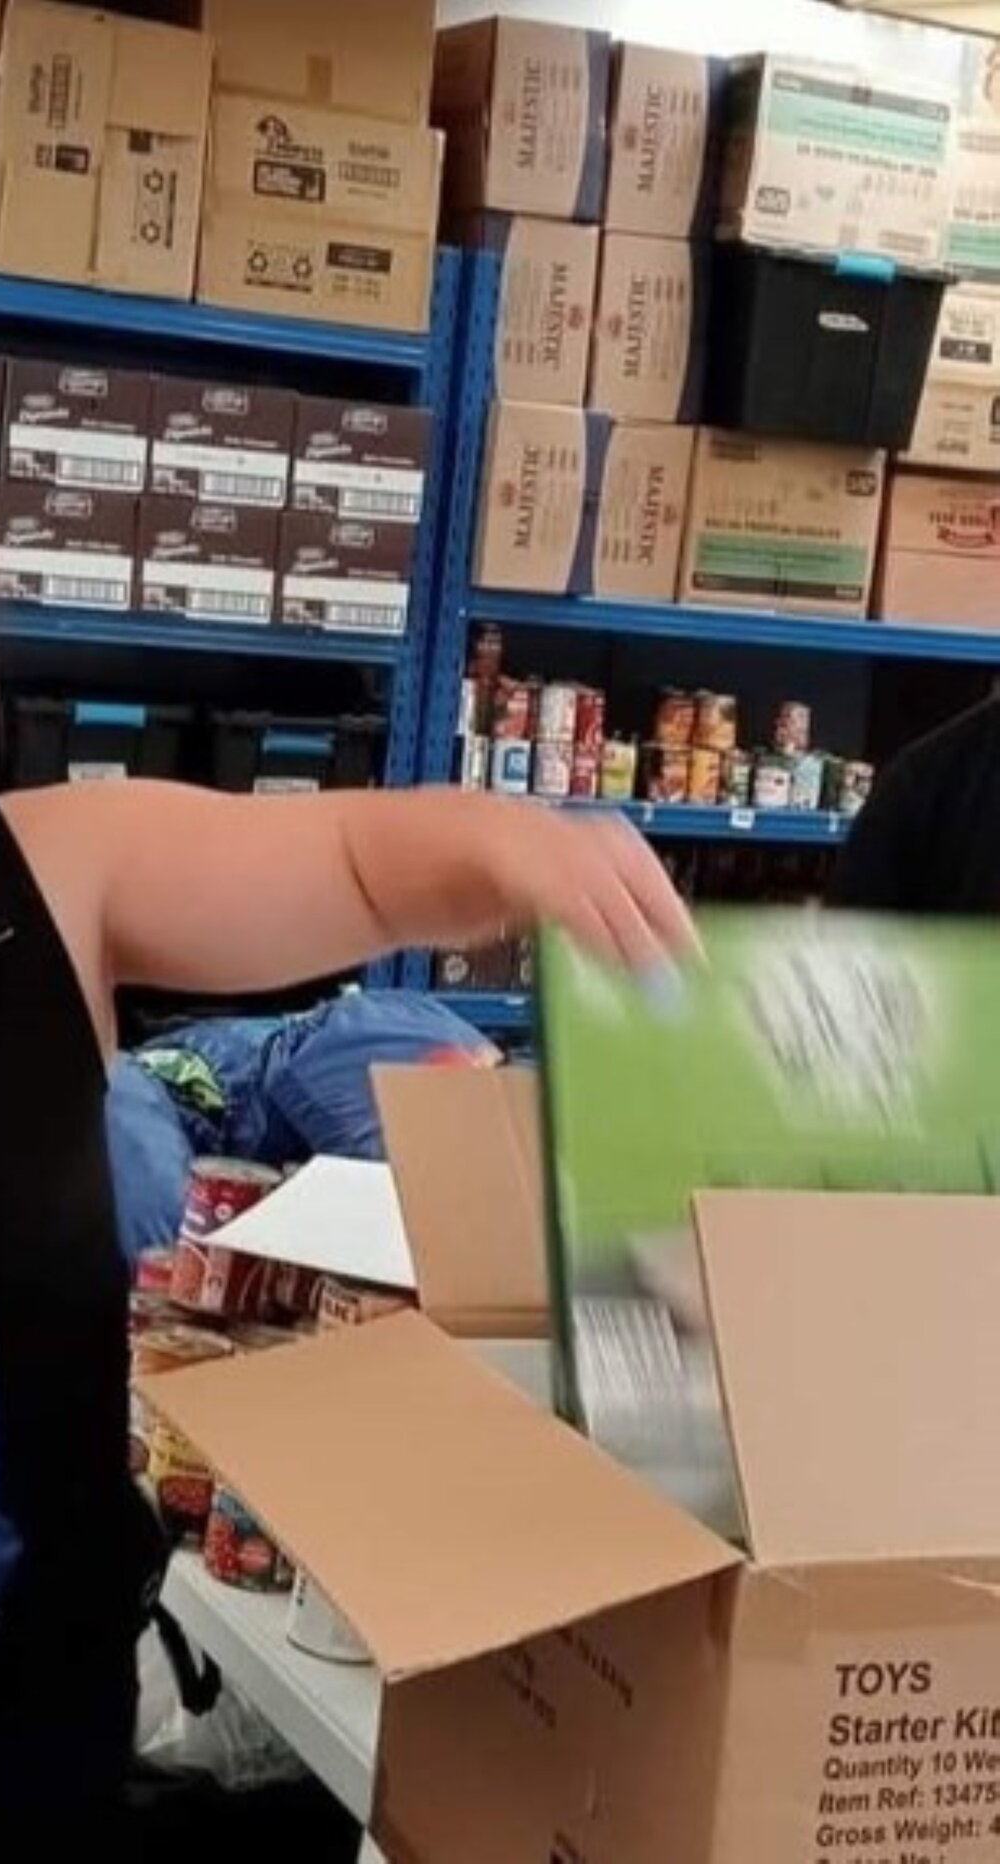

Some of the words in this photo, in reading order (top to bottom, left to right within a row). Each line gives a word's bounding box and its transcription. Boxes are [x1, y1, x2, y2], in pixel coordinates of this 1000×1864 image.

[516, 55, 541, 170] MAJESTIC
[636, 84, 662, 193] MAJESTIC
[543, 261, 568, 371] MAJESTIC
[622, 272, 648, 379] MAJESTIC
[513, 444, 541, 549] MAJESTIC
[636, 464, 665, 566] MAJESTIC
[828, 1712, 947, 1747] Starter
[835, 1660, 932, 1698] TOYS
[818, 1789, 870, 1815] Item
[877, 1785, 926, 1810] Ref:
[823, 1753, 924, 1782] Quantity
[932, 1751, 957, 1774] 10
[816, 1824, 886, 1848] Gross
[894, 1815, 981, 1845] Weight:
